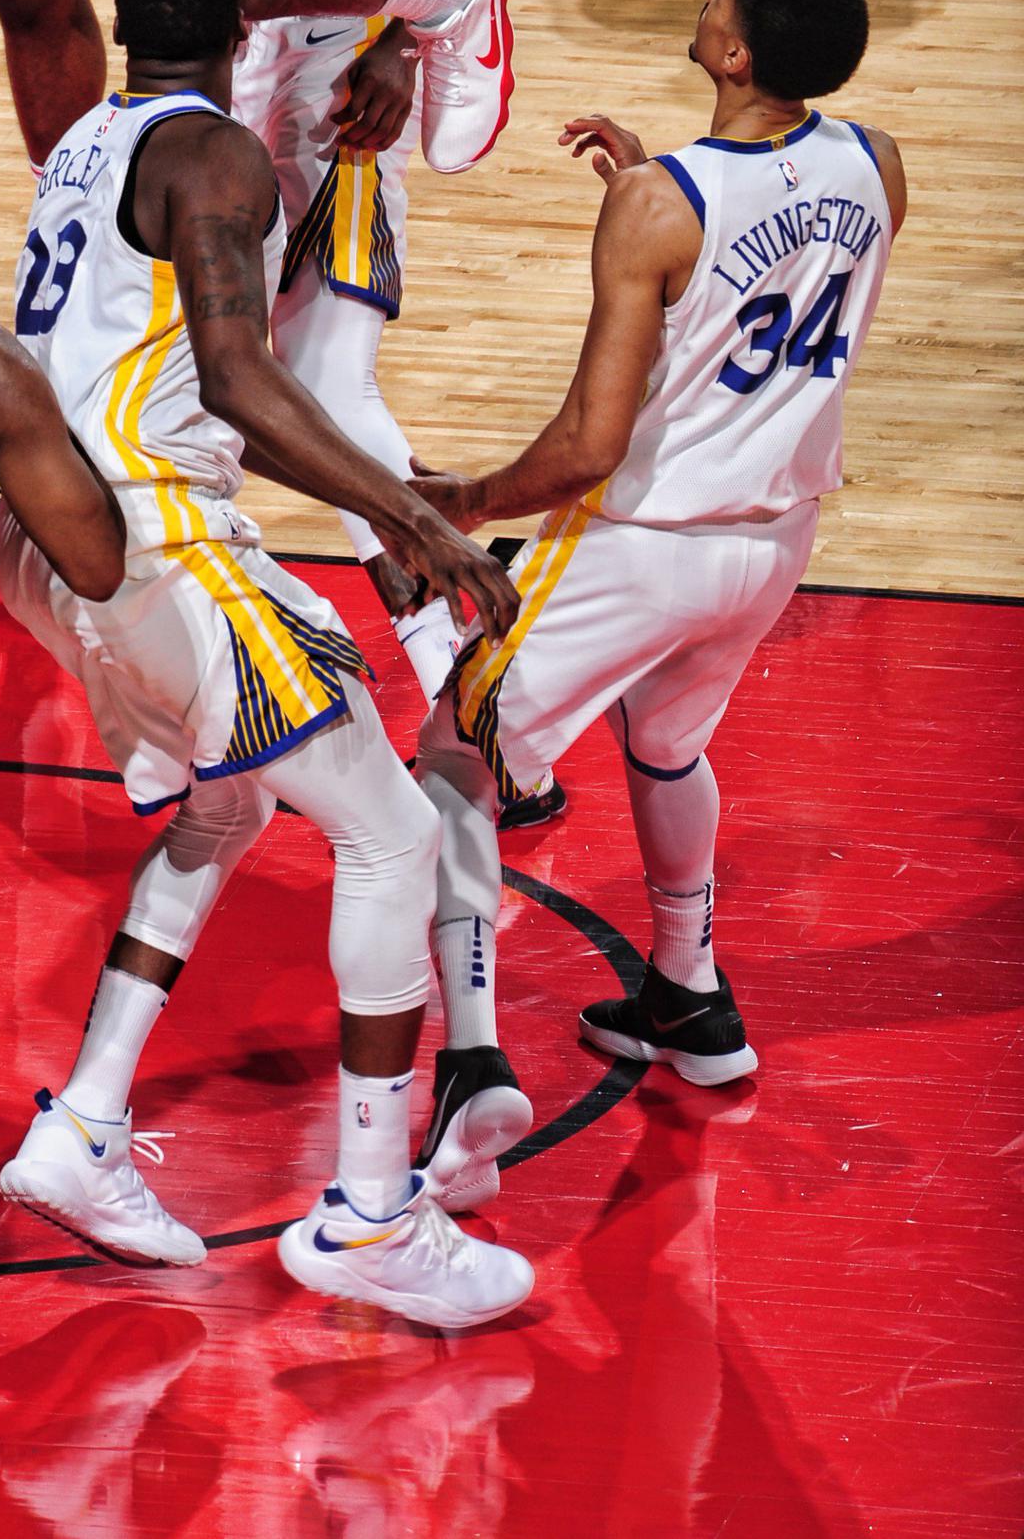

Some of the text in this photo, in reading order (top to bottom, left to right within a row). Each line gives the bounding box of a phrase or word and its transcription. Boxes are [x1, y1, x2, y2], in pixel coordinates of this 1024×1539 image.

[15, 219, 87, 336] 23
[712, 197, 882, 297] LIVINGSTON
[716, 268, 855, 395] 34
